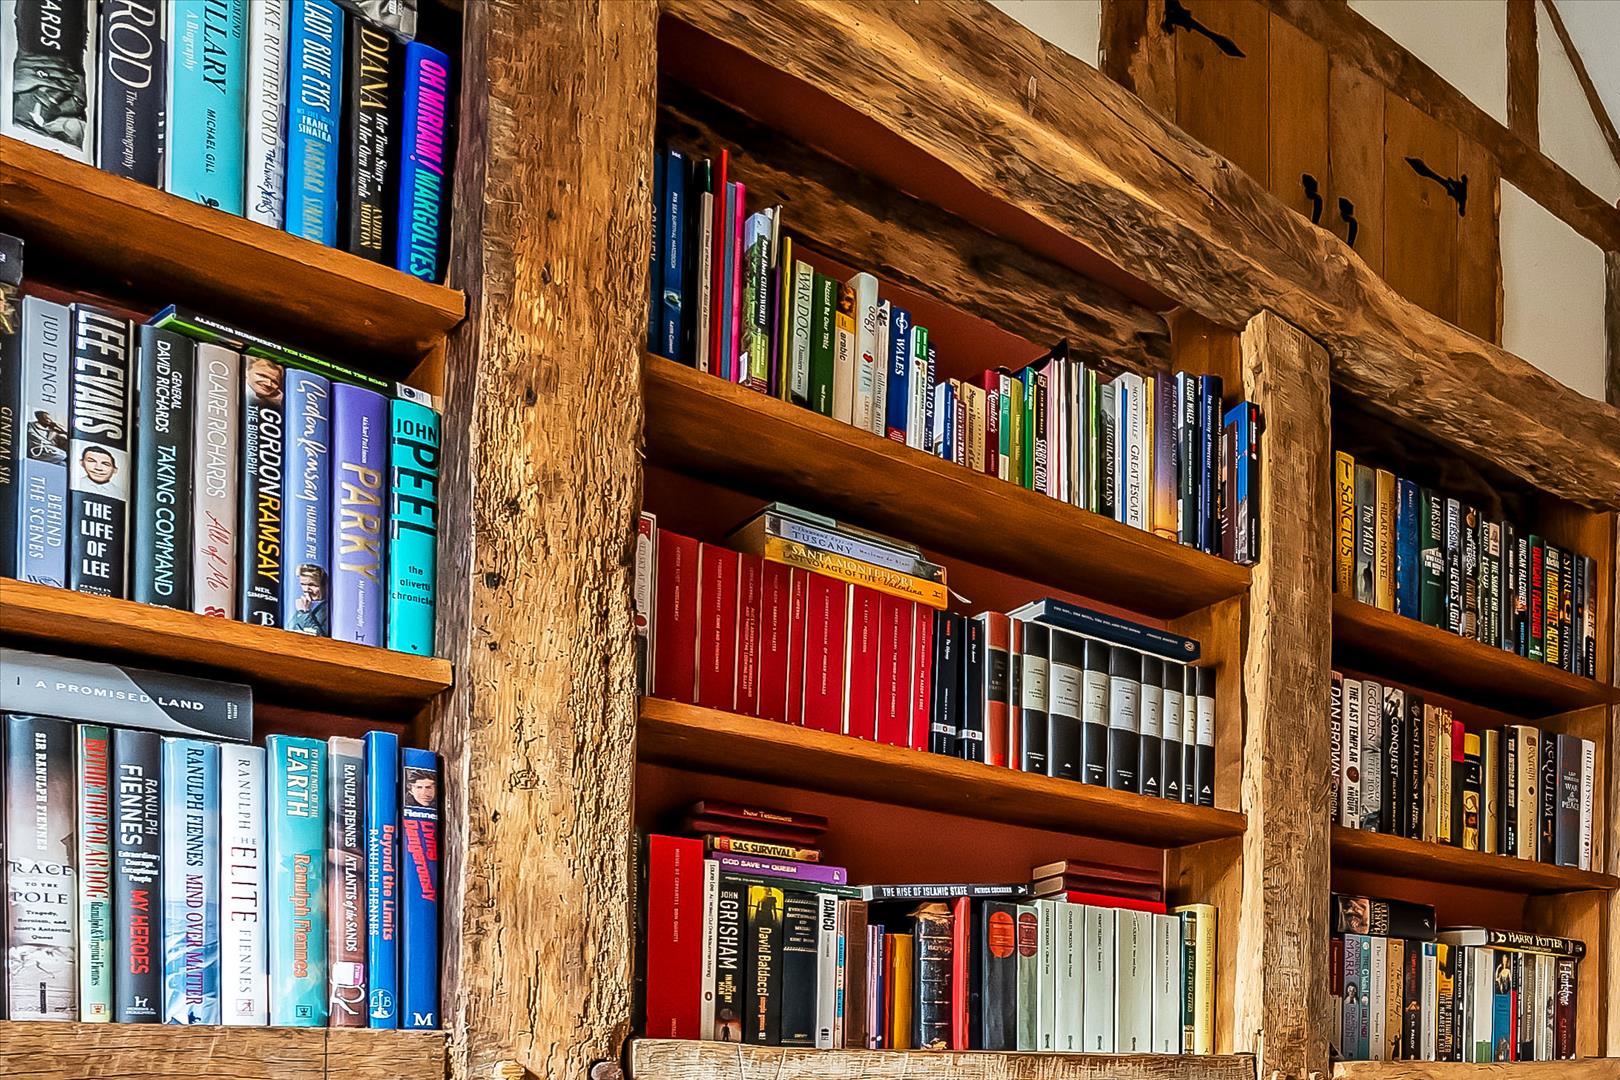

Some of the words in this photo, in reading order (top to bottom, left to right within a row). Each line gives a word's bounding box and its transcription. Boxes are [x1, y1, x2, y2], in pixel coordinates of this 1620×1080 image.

[359, 27, 388, 109] DIANA
[418, 58, 446, 84] OH
[406, 85, 445, 176] MIRIAM!
[409, 169, 441, 281] MARGOLYES
[799, 271, 811, 300] WAR
[41, 314, 58, 347] JUDI
[77, 310, 124, 356] LEE
[796, 303, 810, 339] DOG
[839, 332, 847, 362] arabic
[895, 338, 905, 376] WALES
[40, 352, 57, 404] DENCH
[925, 349, 936, 418] NAVIGATION
[74, 360, 124, 442] EVANS
[155, 378, 169, 434] RICHARDS
[396, 417, 438, 438] JOHN
[247, 427, 259, 476] BIOGRAPHY
[1130, 444, 1139, 479] GREAT
[31, 476, 45, 507] THE
[157, 444, 175, 504] TAKING
[47, 493, 62, 547] BEHIND
[83, 501, 112, 521] THE
[1130, 481, 1140, 521] ESCAPE
[1340, 482, 1353, 556] SANCTUS
[1431, 496, 1440, 540] LARSSON
[29, 510, 44, 559] SCENES
[81, 521, 114, 541] LIFE
[339, 462, 383, 584] PARKY
[792, 532, 852, 554] TUSCANY
[1363, 525, 1374, 556] YARD
[82, 561, 110, 579] LEE
[86, 542, 107, 559] OF
[154, 505, 175, 596] COMMAND
[408, 565, 424, 576] the
[1532, 546, 1542, 590] DUNCAN
[1531, 594, 1542, 639] FALCONER
[1546, 624, 1559, 664] ACTION
[55, 682, 149, 704] PROMISED
[158, 696, 204, 712] LAND
[1367, 685, 1376, 742] IGGULDEN
[1348, 727, 1358, 768] TEMPLAR
[1390, 716, 1400, 778] CONQUEST
[186, 748, 204, 801] RANULPH
[286, 746, 311, 817] EARTH
[1541, 740, 1555, 817] REQUIEM
[119, 764, 143, 845] FIENNES
[144, 778, 157, 836] RANULPH
[186, 803, 204, 867] FIENNES
[732, 841, 749, 852] SAS
[750, 843, 792, 859] SURVIVAL
[229, 847, 258, 923] ELITE
[722, 857, 740, 867] GOD
[741, 860, 760, 869] SAVE
[771, 864, 796, 873] QUEEN
[129, 890, 148, 912] MY
[186, 874, 204, 907] MIND
[882, 887, 896, 897] THE
[897, 887, 912, 897] RISE
[913, 887, 922, 896] OF
[923, 887, 949, 896] ISLAMIC
[950, 886, 967, 896] STATE
[186, 909, 204, 942] OVER
[719, 900, 738, 970] GRISHAM
[822, 898, 835, 931] BANCO
[129, 914, 150, 975] HEROES
[758, 927, 772, 955] David
[1508, 932, 1534, 946] HARRY
[1535, 935, 1563, 949] POTTER
[184, 944, 204, 1006] MATTER
[757, 955, 771, 997] Baldacci
